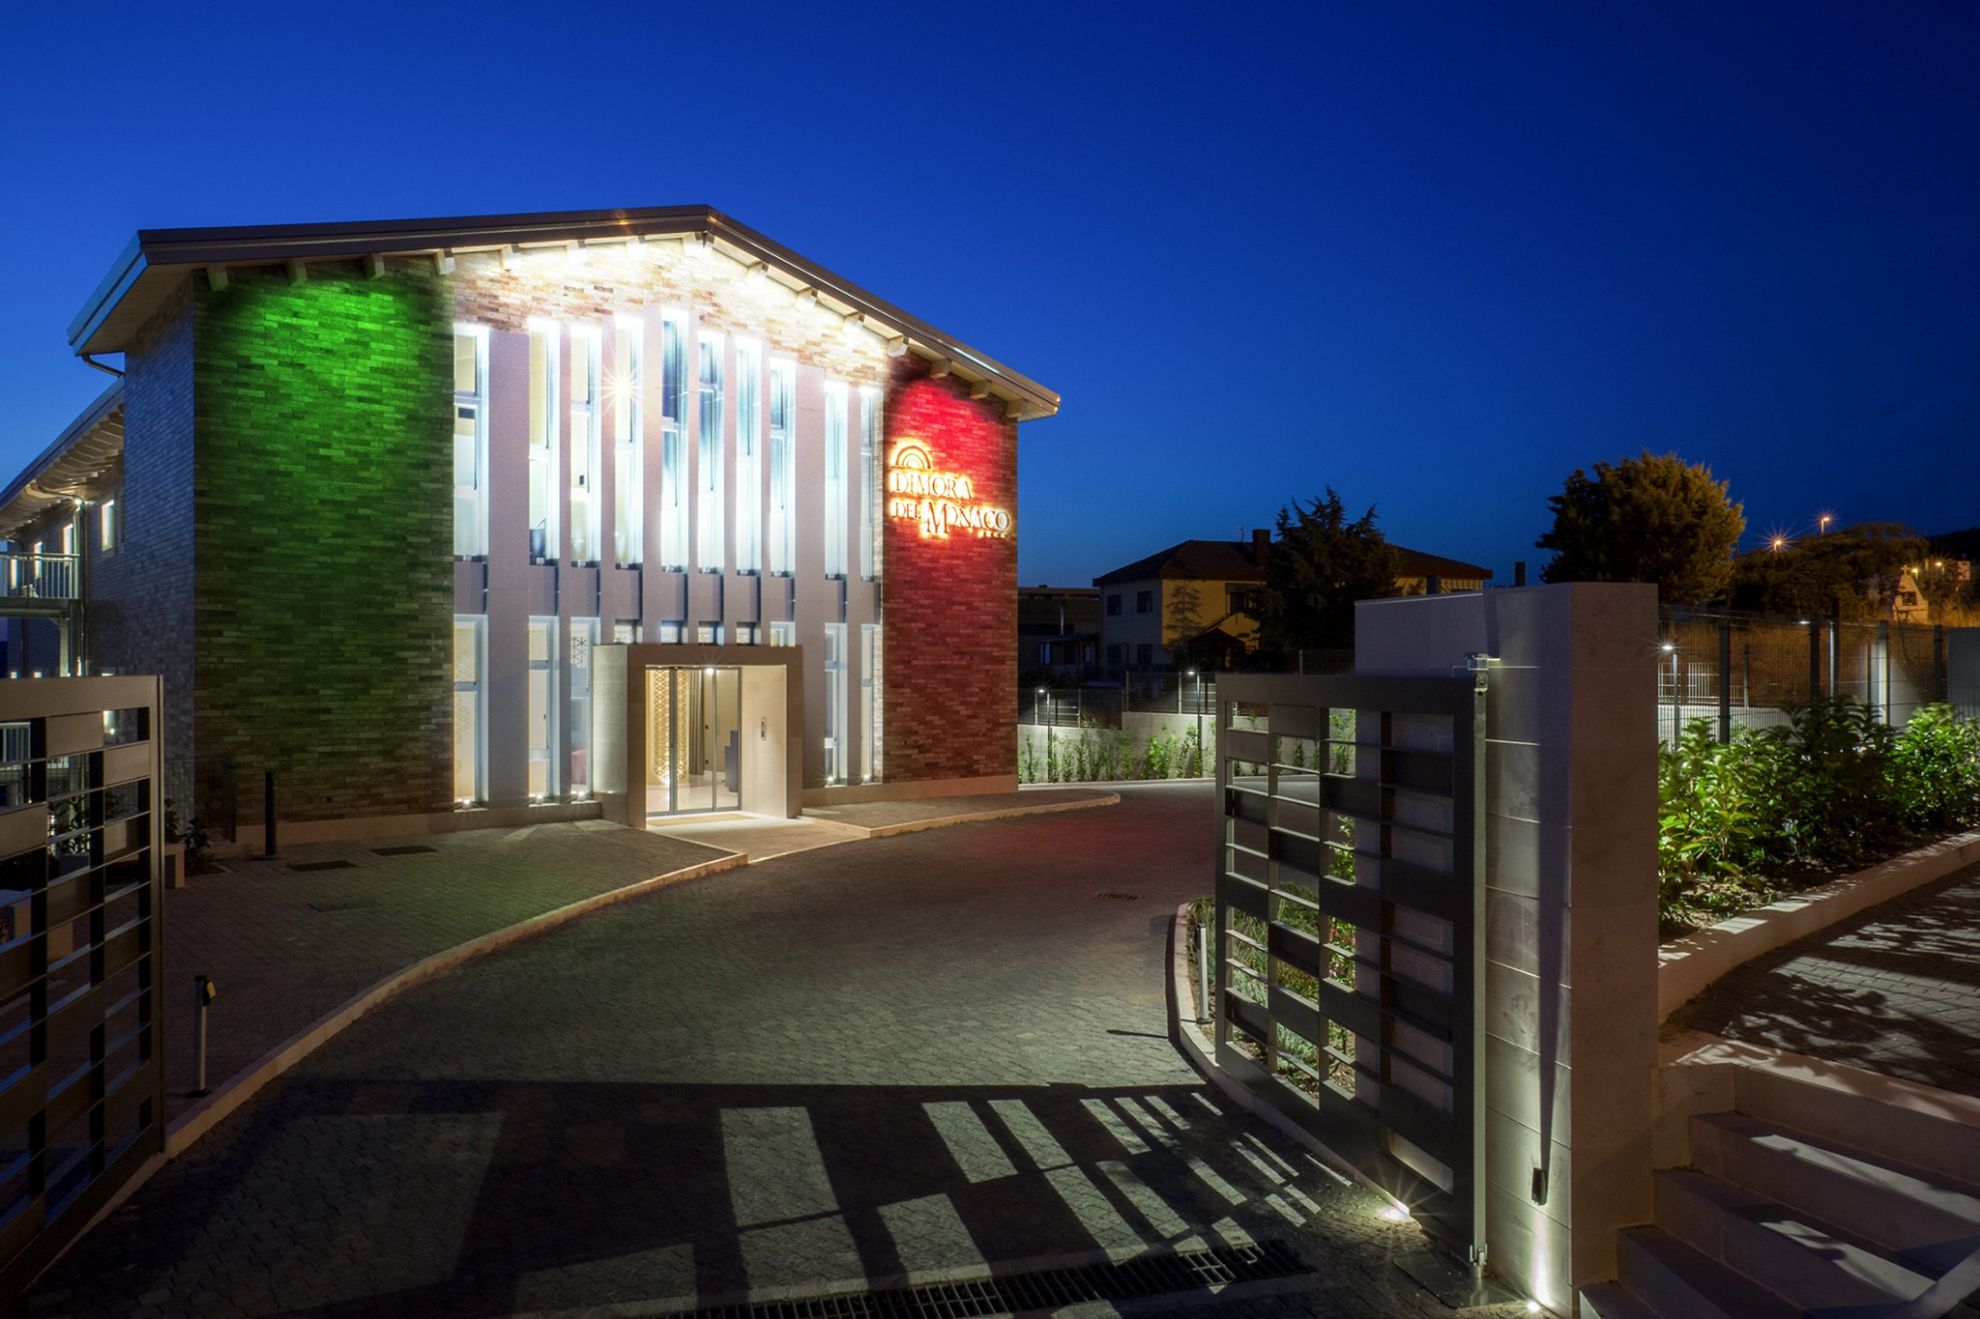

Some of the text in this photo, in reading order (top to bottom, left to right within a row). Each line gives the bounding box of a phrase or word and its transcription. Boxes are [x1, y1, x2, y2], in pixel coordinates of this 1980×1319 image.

[894, 472, 973, 500] DIMORA
[891, 501, 1010, 535] DEL MONACO
